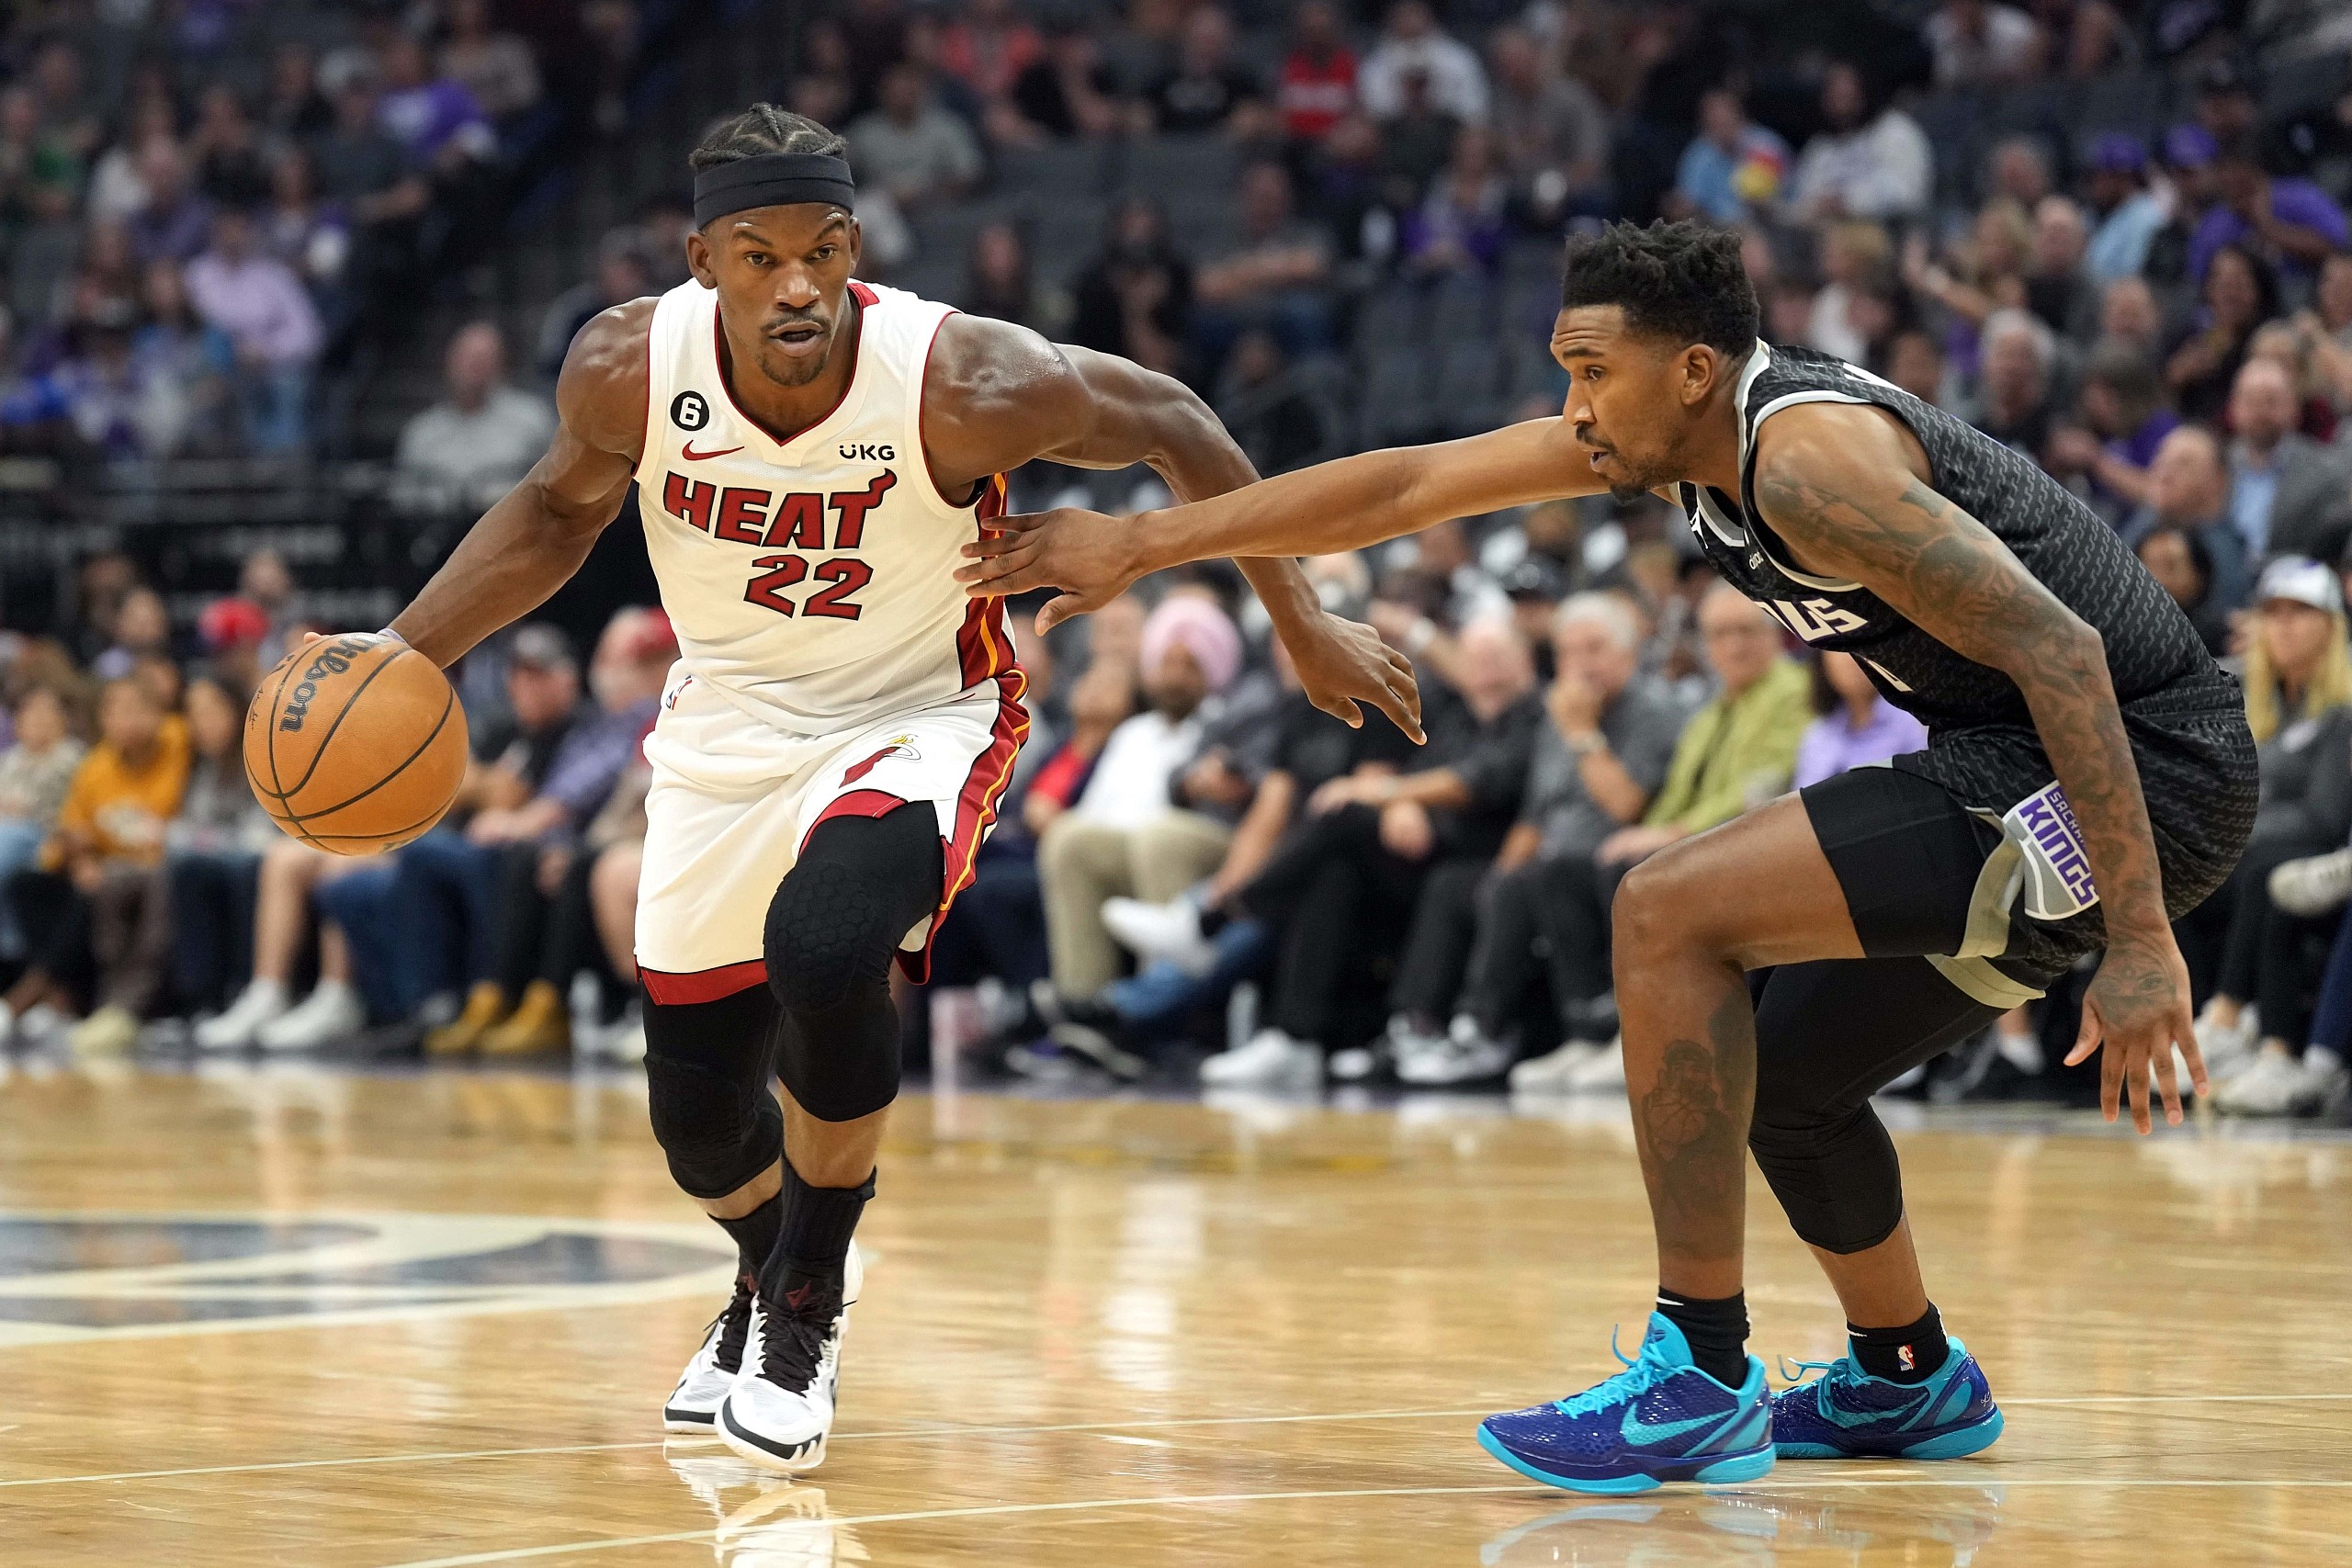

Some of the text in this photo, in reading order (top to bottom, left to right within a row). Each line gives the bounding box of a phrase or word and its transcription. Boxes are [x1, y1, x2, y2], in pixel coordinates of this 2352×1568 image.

[678, 396, 702, 427] 6
[662, 468, 898, 550] HEAT
[743, 554, 875, 622] 22
[2018, 796, 2095, 906] KINGS
